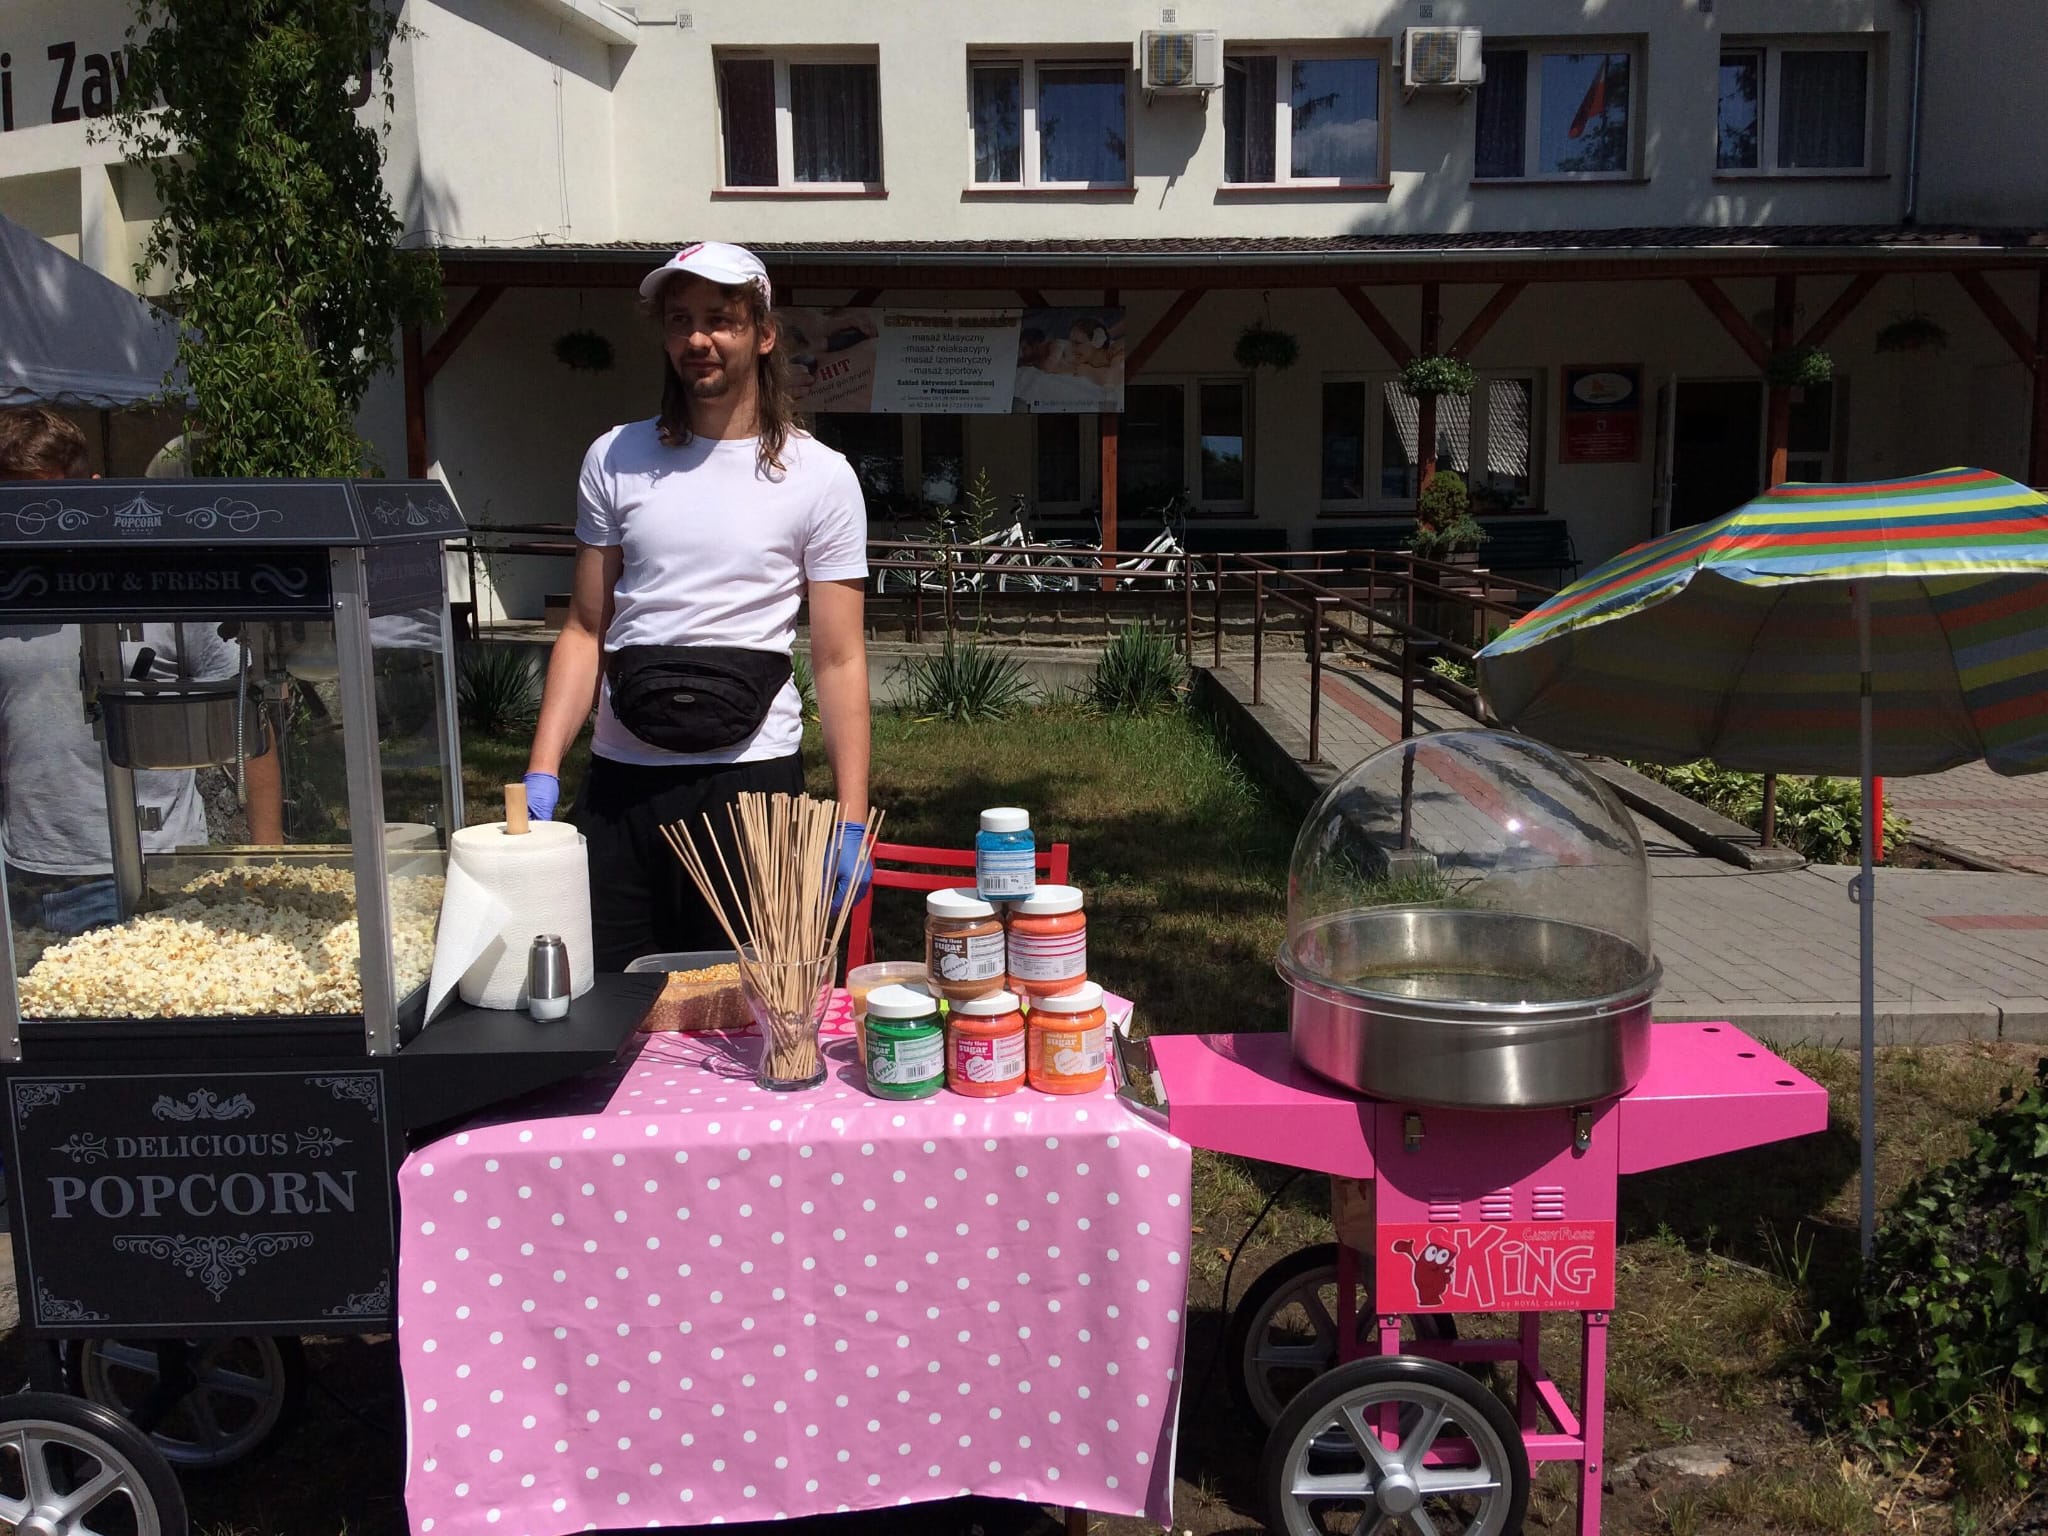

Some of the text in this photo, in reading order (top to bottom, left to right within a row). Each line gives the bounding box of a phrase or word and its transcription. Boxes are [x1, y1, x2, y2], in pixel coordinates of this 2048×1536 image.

[943, 332, 985, 343] klasyczny
[937, 344, 990, 355] relaksacyjny
[936, 355, 992, 366] izometryczny
[819, 358, 850, 381] HIT
[944, 366, 984, 377] sportowy
[112, 516, 162, 528] POPCORN
[56, 570, 240, 593] HOT & FRESH
[934, 942, 963, 953] sugar
[1046, 1038, 1078, 1048] sugar
[959, 1045, 988, 1056] sugar
[875, 1061, 897, 1078] APPLE
[114, 1133, 289, 1159] DELICIOUS
[47, 1170, 357, 1219] POPCORN
[1544, 1300, 1580, 1308] catering
